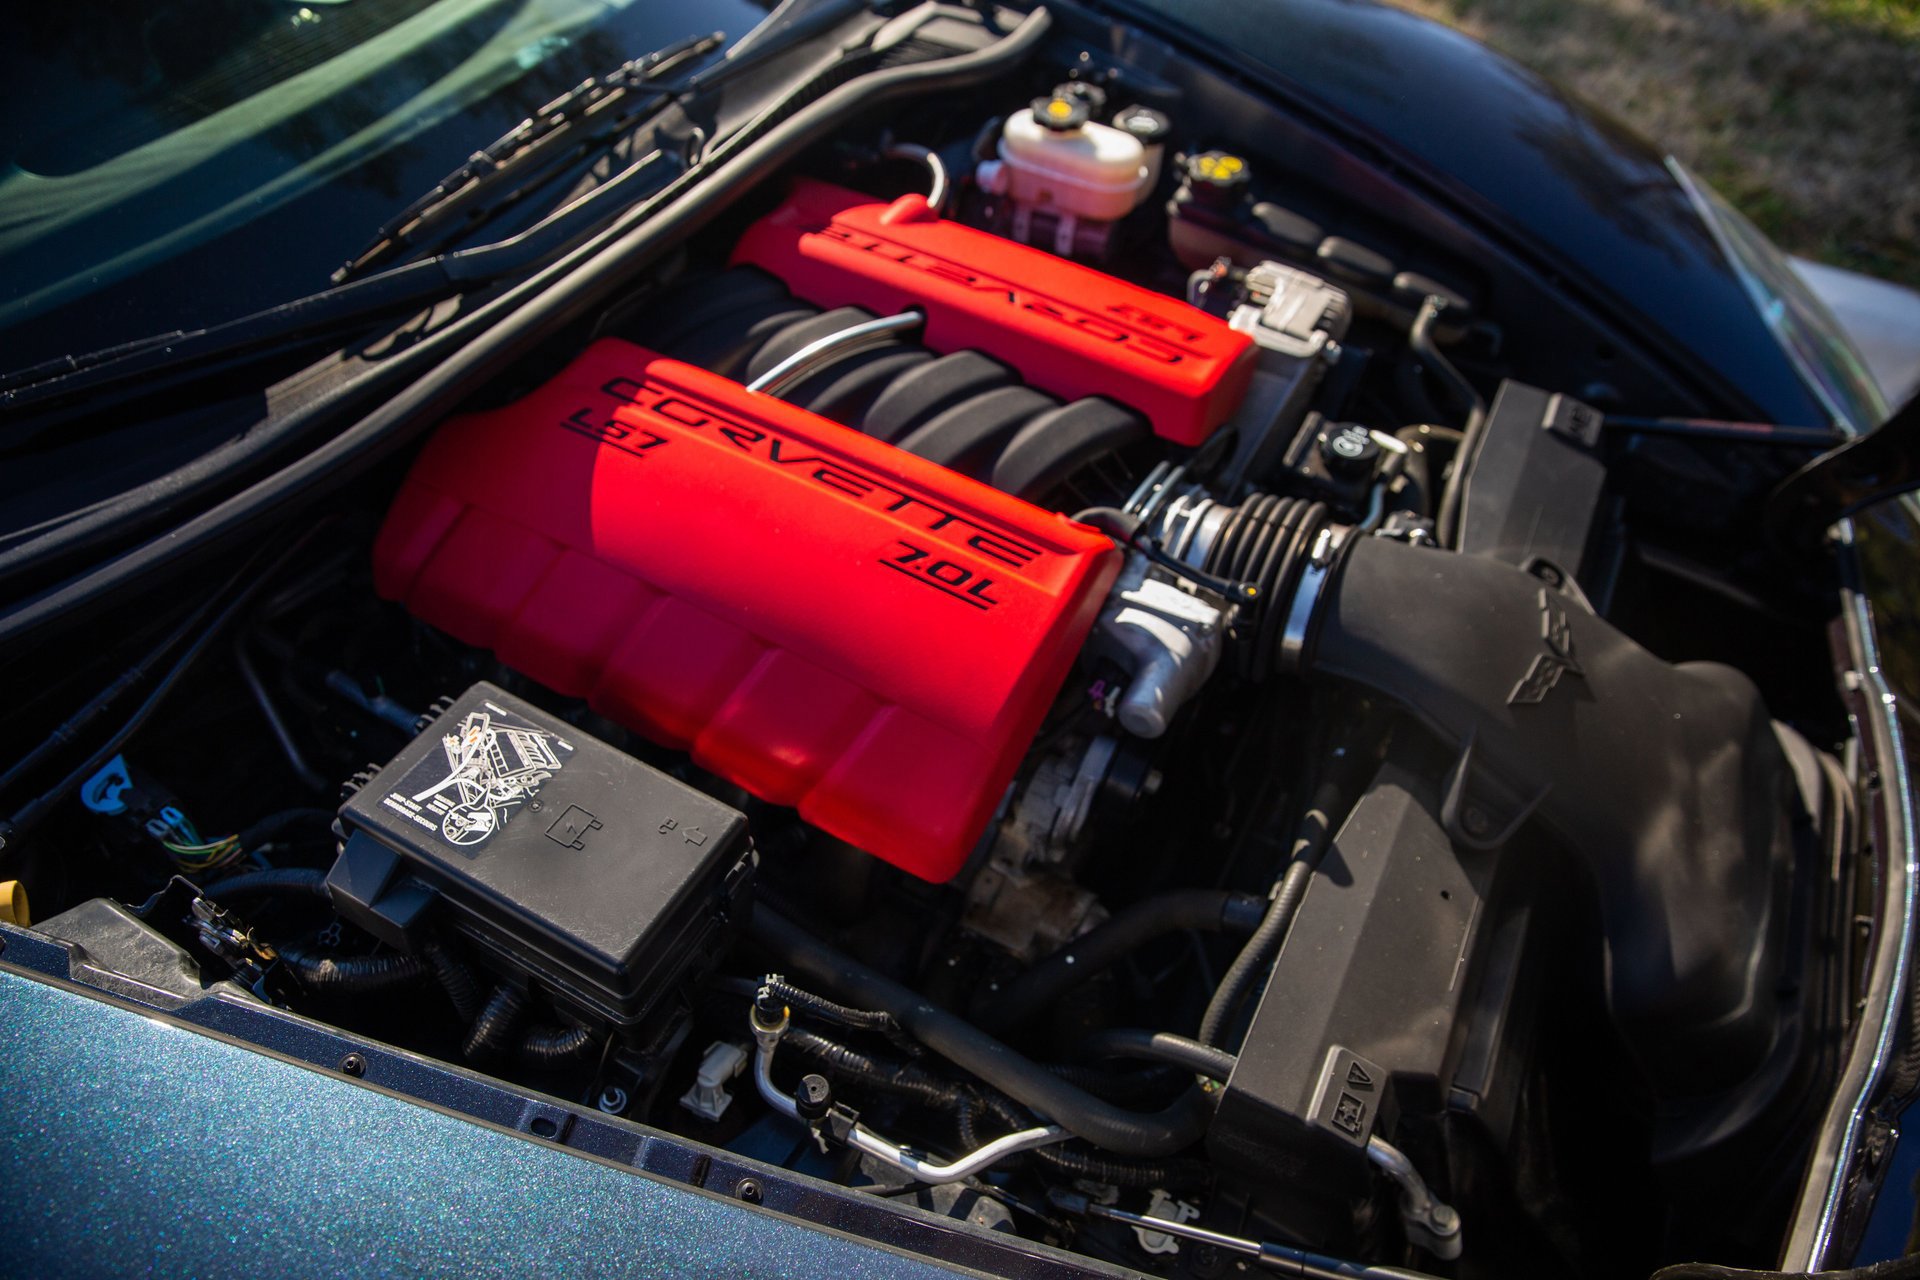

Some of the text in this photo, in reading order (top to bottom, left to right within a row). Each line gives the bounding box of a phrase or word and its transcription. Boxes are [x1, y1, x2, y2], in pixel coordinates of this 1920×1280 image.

[567, 407, 669, 450] LS7
[600, 376, 1043, 568] CORVETTE
[894, 540, 999, 605] 7.0L
